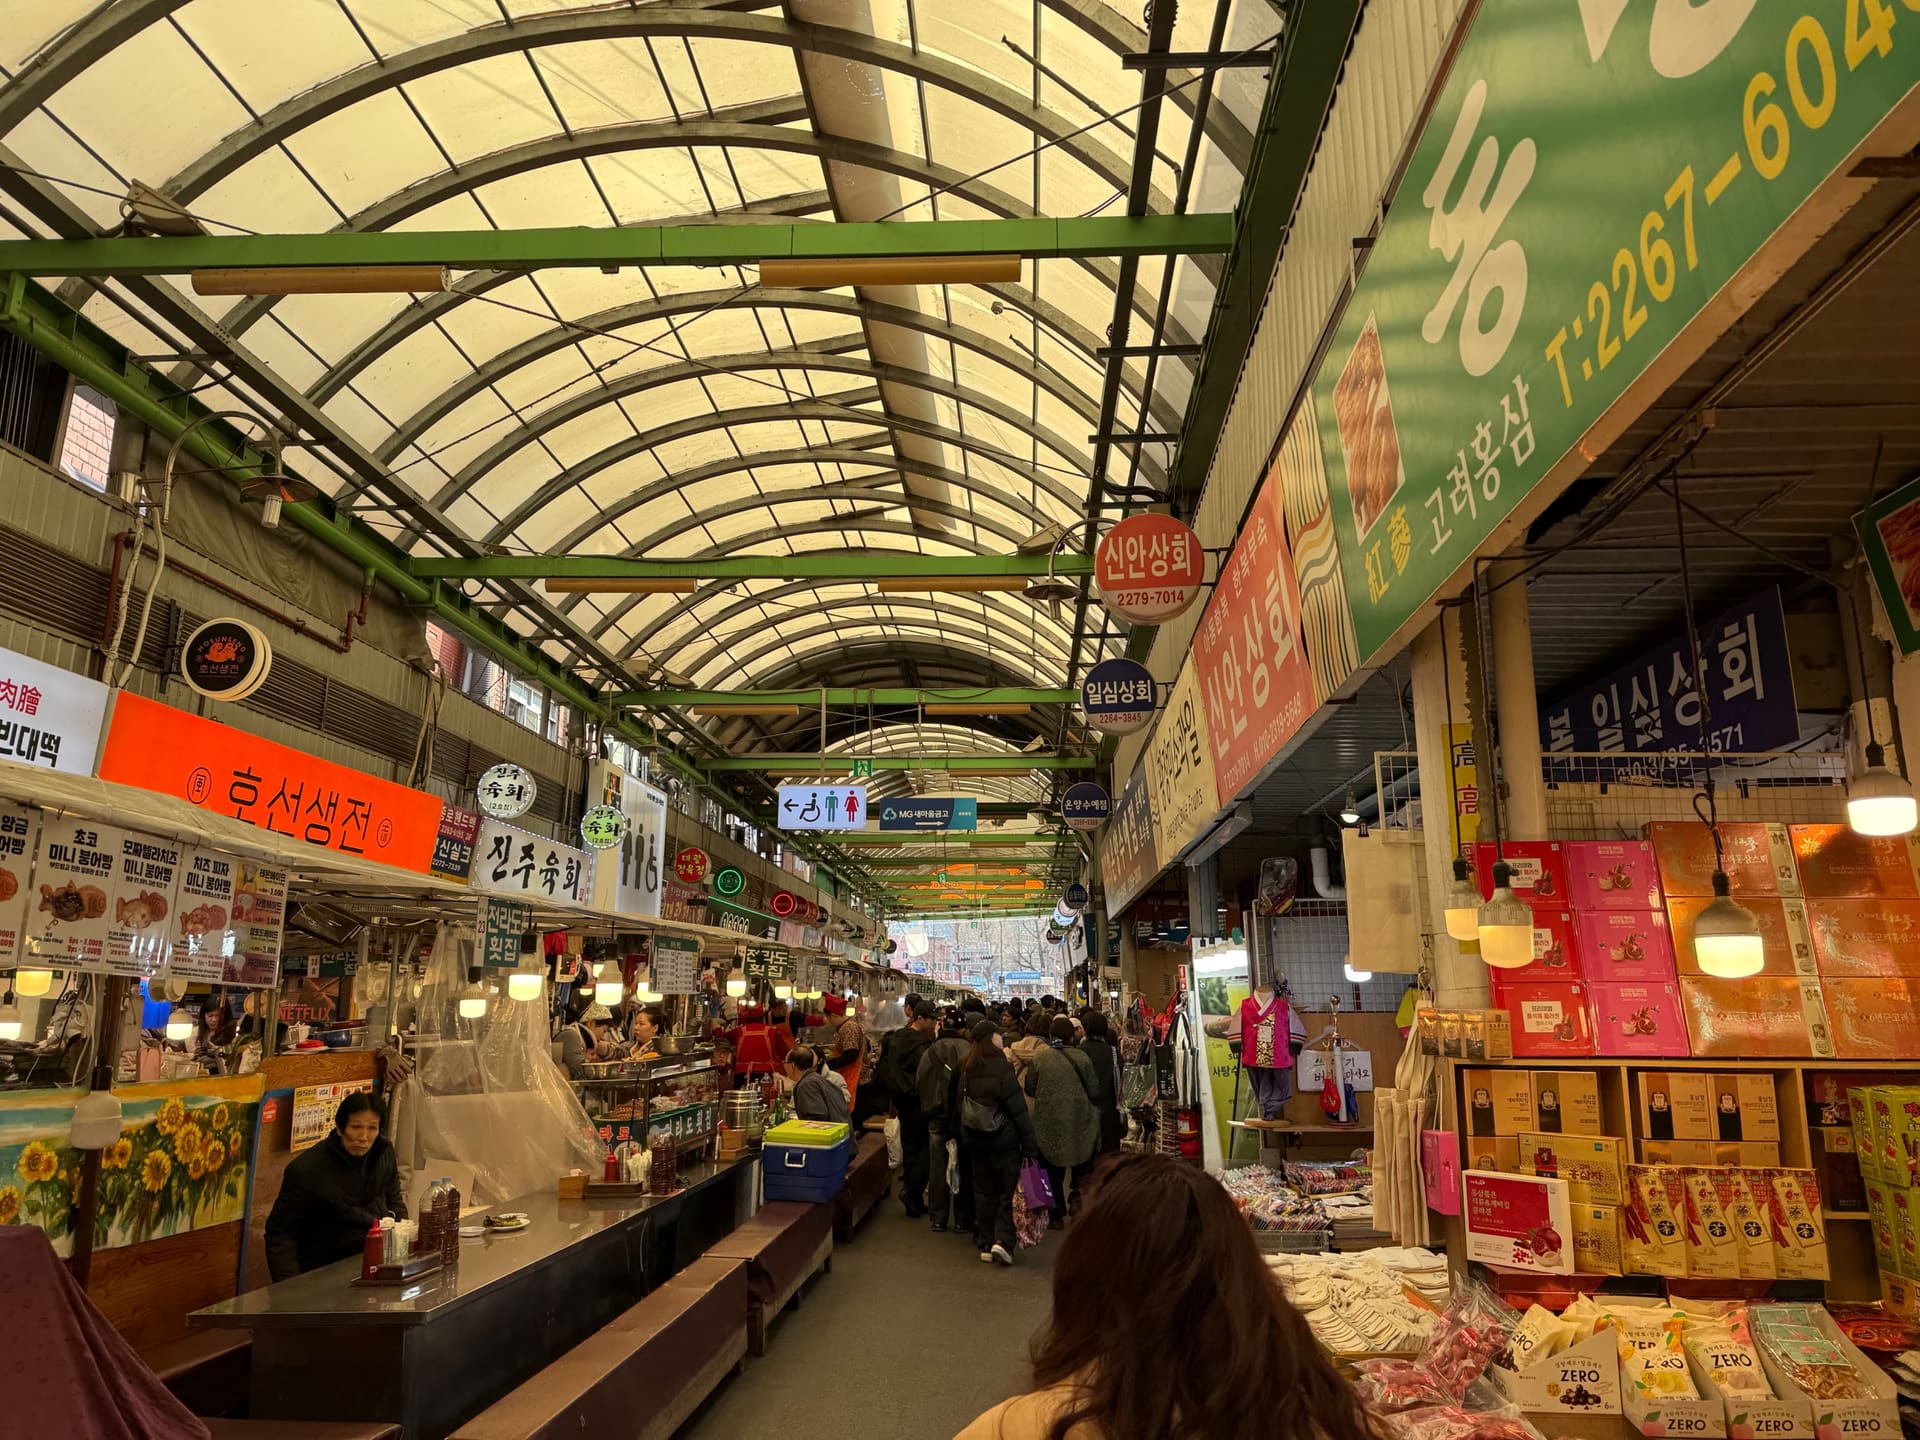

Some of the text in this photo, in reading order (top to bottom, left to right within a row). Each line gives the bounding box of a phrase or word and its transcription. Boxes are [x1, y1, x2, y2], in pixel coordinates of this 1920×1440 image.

[1545, 0, 1920, 408] T:2267-604
[1424, 374, 1536, 556] 고려홍삼
[1105, 531, 1192, 581] 신안상회
[1232, 517, 1268, 598] 한복부속
[1117, 589, 1185, 606] 2279-7014
[1207, 550, 1300, 761] 신안상회
[1086, 680, 1152, 706] 일심상회
[1592, 614, 1764, 761] 일심상회
[1100, 712, 1142, 724] 2264-3845
[493, 768, 520, 780] 진주
[483, 781, 524, 801] 육회
[226, 766, 373, 855] 호선생전
[593, 810, 614, 820] 진주
[899, 810, 913, 818] MG
[1065, 799, 1107, 811] 온양수예점
[1, 815, 29, 836] 앙금
[585, 821, 619, 836] 육회
[73, 828, 98, 848] 초코
[50, 844, 114, 871] 미니 붕어빵
[193, 856, 230, 876] 치즈 피자
[486, 835, 583, 900] 진주육회
[124, 859, 144, 876] 미니
[146, 863, 173, 883] 붕어빵
[186, 871, 204, 887] 미니
[206, 875, 232, 894] 붕어빵
[487, 905, 522, 935] 전라도
[488, 935, 516, 961] 횟집
[278, 1007, 331, 1020] NETFLIX
[1314, 1057, 1355, 1067] 쓰기
[1512, 1331, 1534, 1351] ERO
[1711, 1353, 1752, 1369] ZERO
[1561, 1369, 1600, 1382] ZERO
[1668, 1418, 1706, 1430] ZERO
[1755, 1419, 1794, 1431] ZERO
[1841, 1418, 1881, 1431] ZERO
